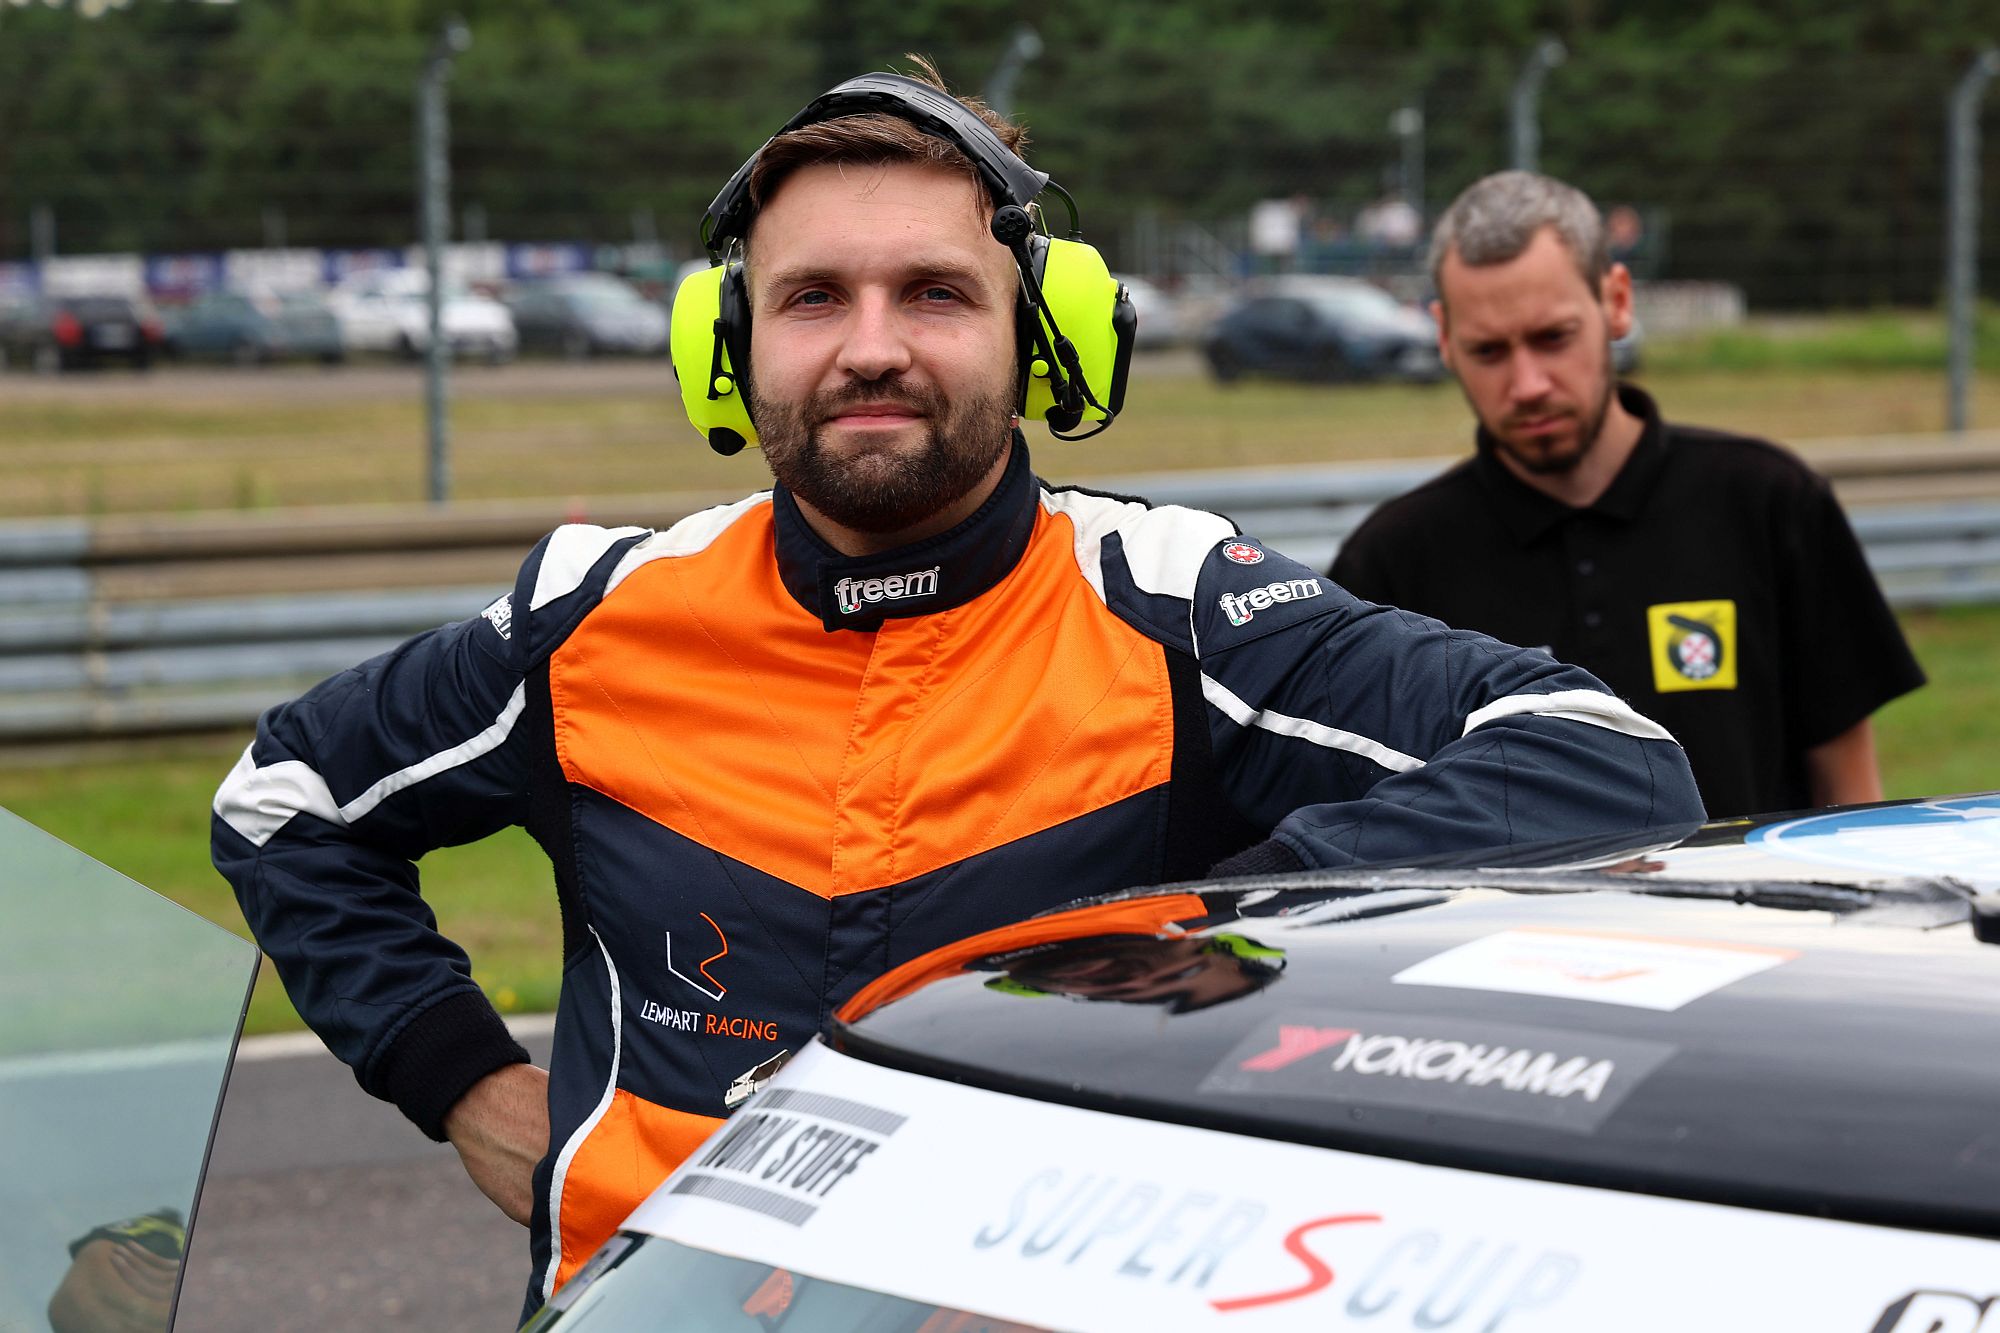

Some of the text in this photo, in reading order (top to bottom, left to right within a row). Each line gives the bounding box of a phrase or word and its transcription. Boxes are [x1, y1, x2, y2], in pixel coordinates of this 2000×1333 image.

[835, 570, 938, 613] freem
[1219, 579, 1323, 626] freem
[640, 999, 778, 1041] LEMPART RACING
[1332, 1033, 1614, 1102] YOKOHAMA
[761, 1124, 880, 1197] STUFF
[972, 1167, 1269, 1291] SUPER
[1344, 1228, 1584, 1333] CUP
